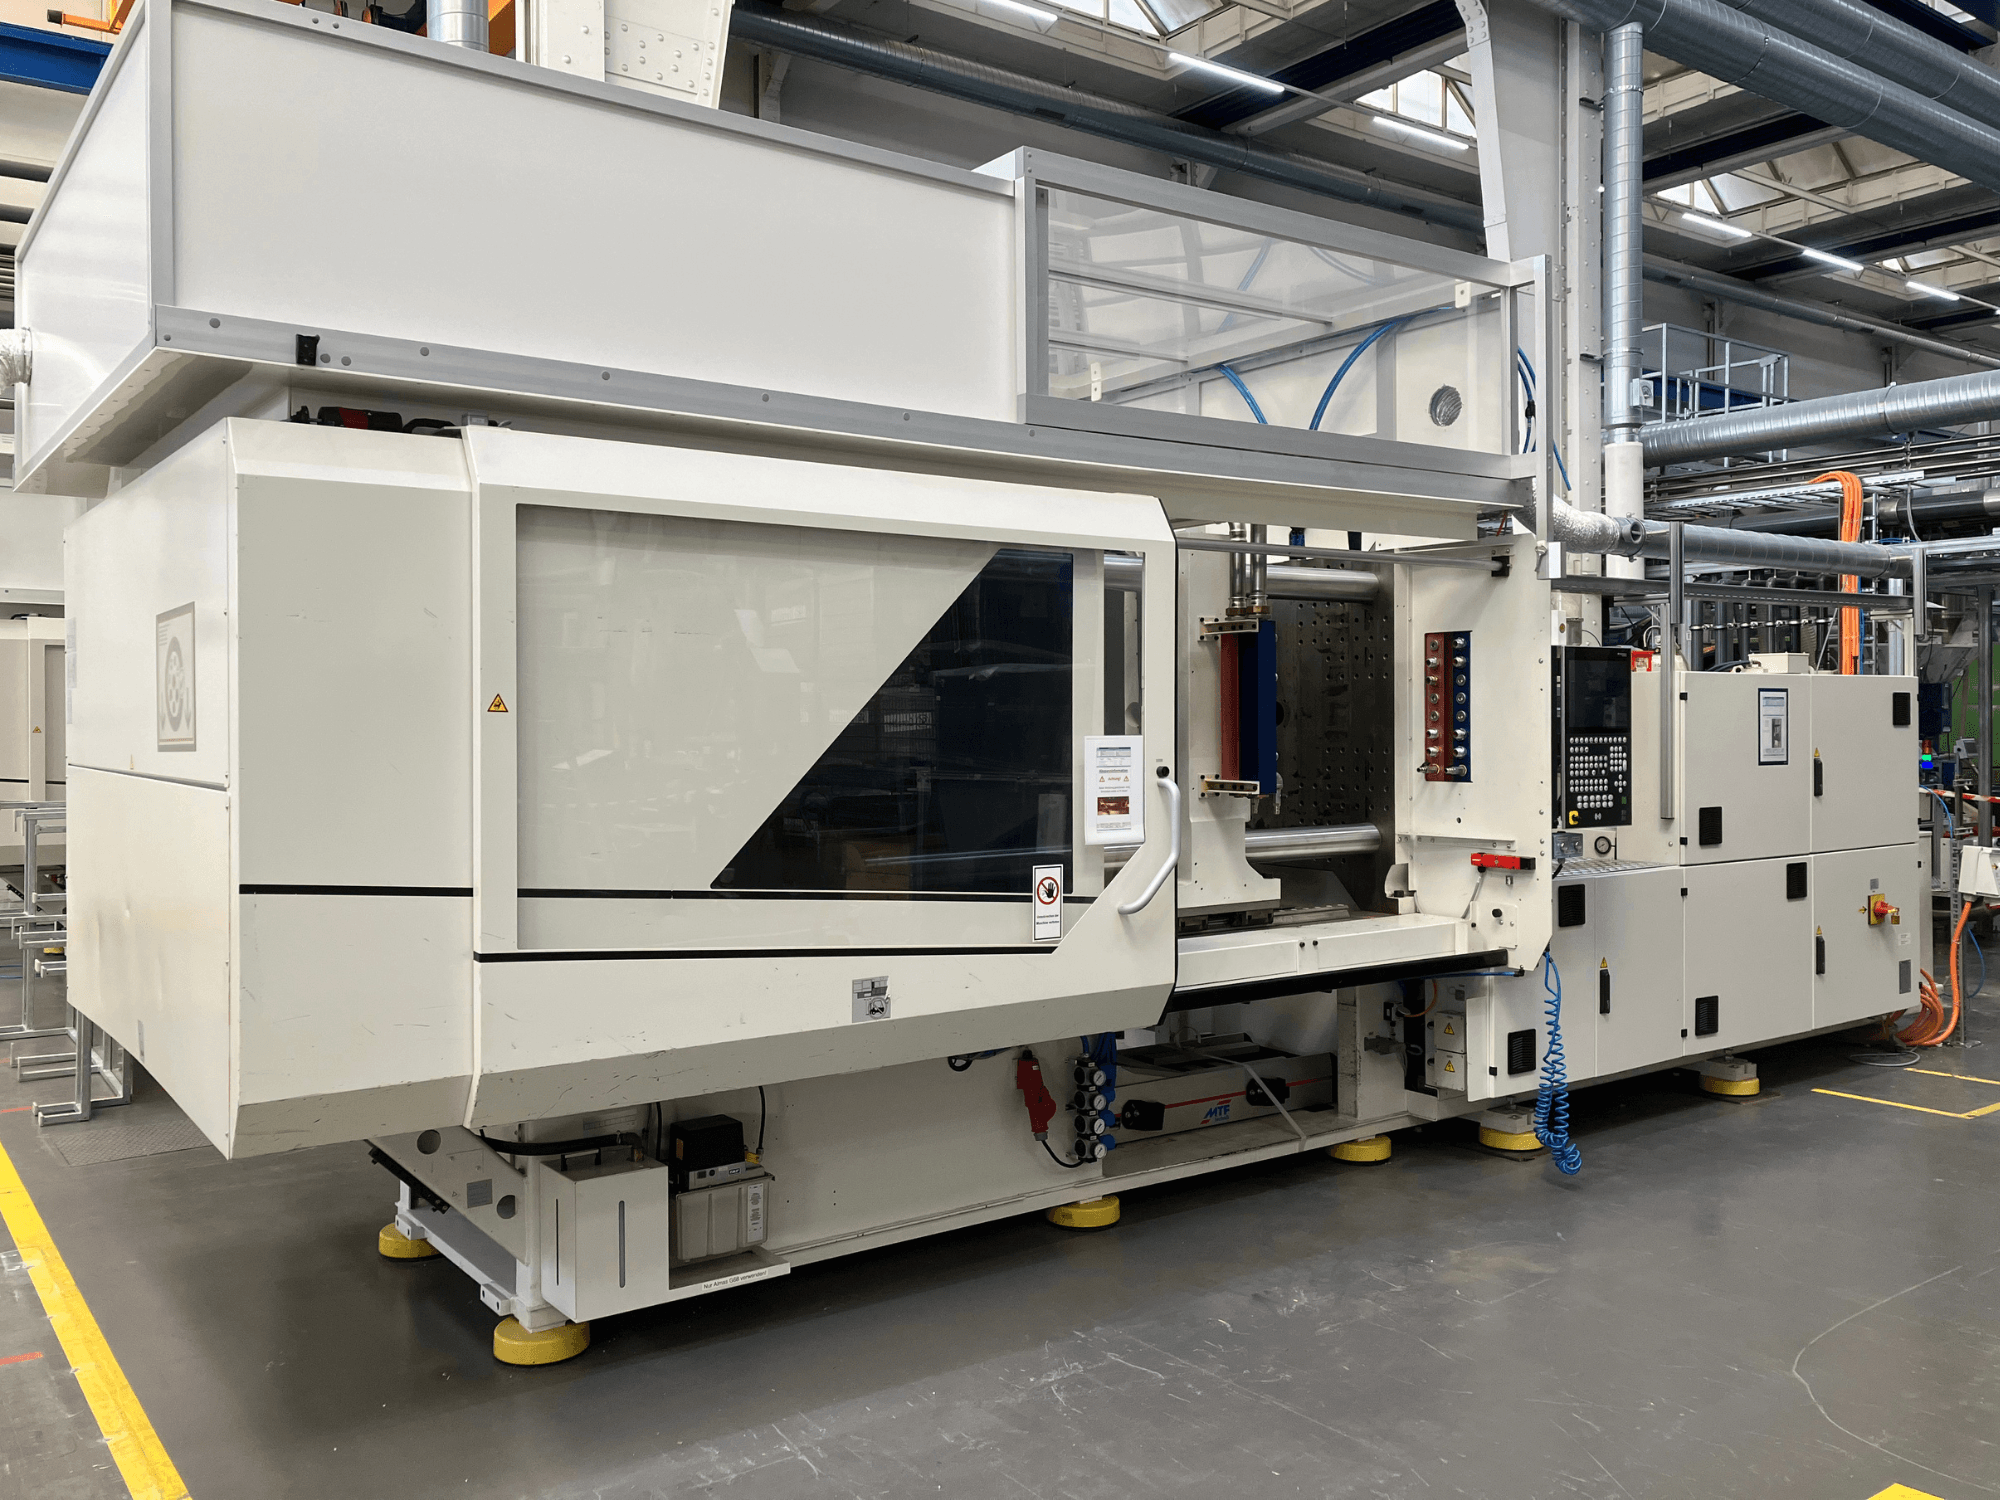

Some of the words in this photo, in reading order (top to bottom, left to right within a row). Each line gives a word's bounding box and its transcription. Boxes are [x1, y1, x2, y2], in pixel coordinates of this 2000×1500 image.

[1203, 1104, 1230, 1119] MTF
[713, 1279, 728, 1287] Almas
[740, 1271, 767, 1281] verwenden!
